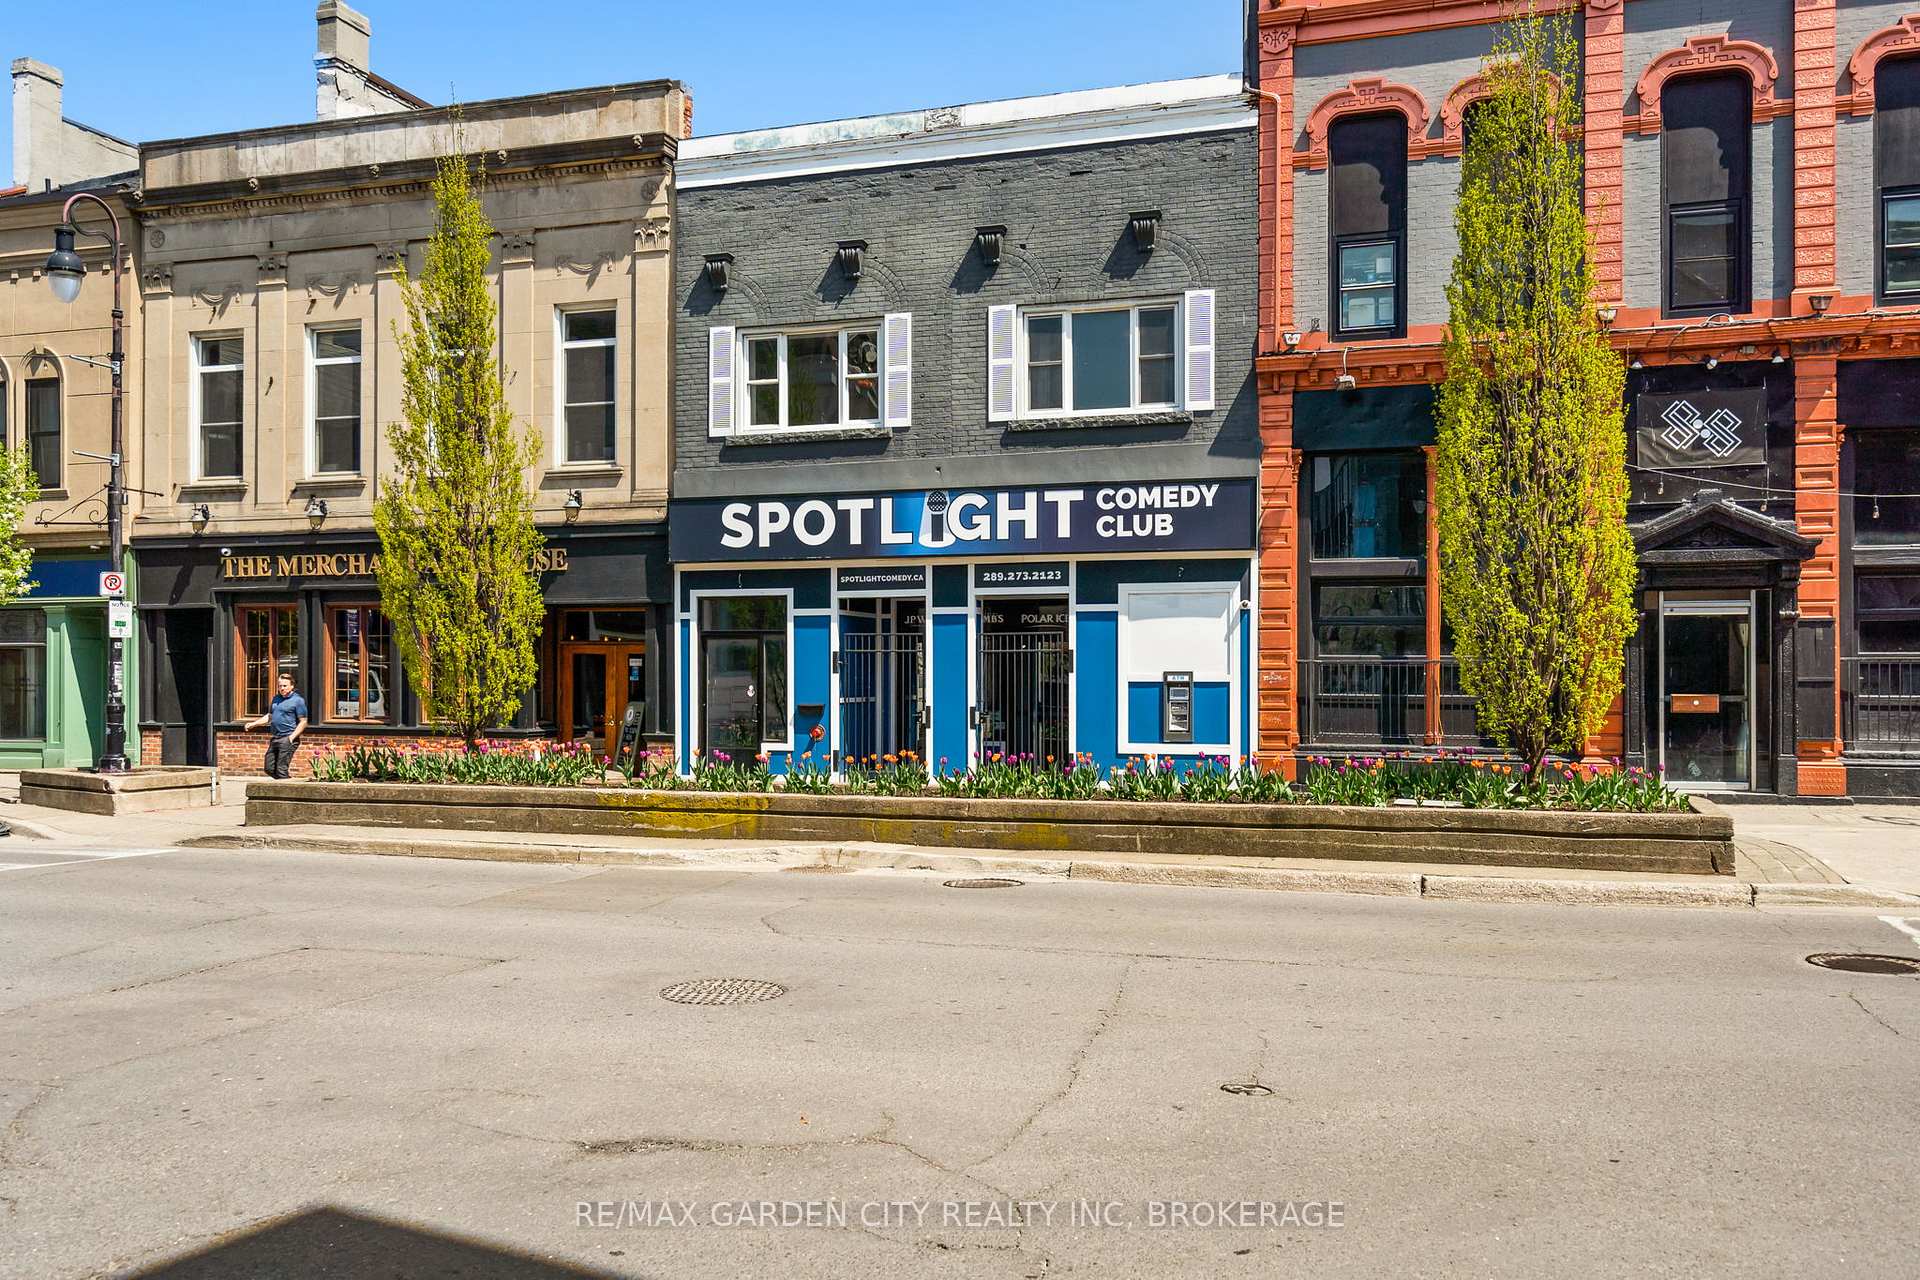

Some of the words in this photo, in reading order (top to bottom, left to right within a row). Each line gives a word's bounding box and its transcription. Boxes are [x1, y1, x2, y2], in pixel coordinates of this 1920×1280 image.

[1095, 483, 1220, 511] COMEDY
[1095, 513, 1175, 539] CLUB
[221, 556, 272, 578] THE
[276, 553, 384, 577] MERCHA
[840, 575, 924, 584] SPOTLIGHTCOMEDY.CA
[983, 570, 1062, 582] 289.273.2123
[1020, 613, 1054, 624] POLAR
